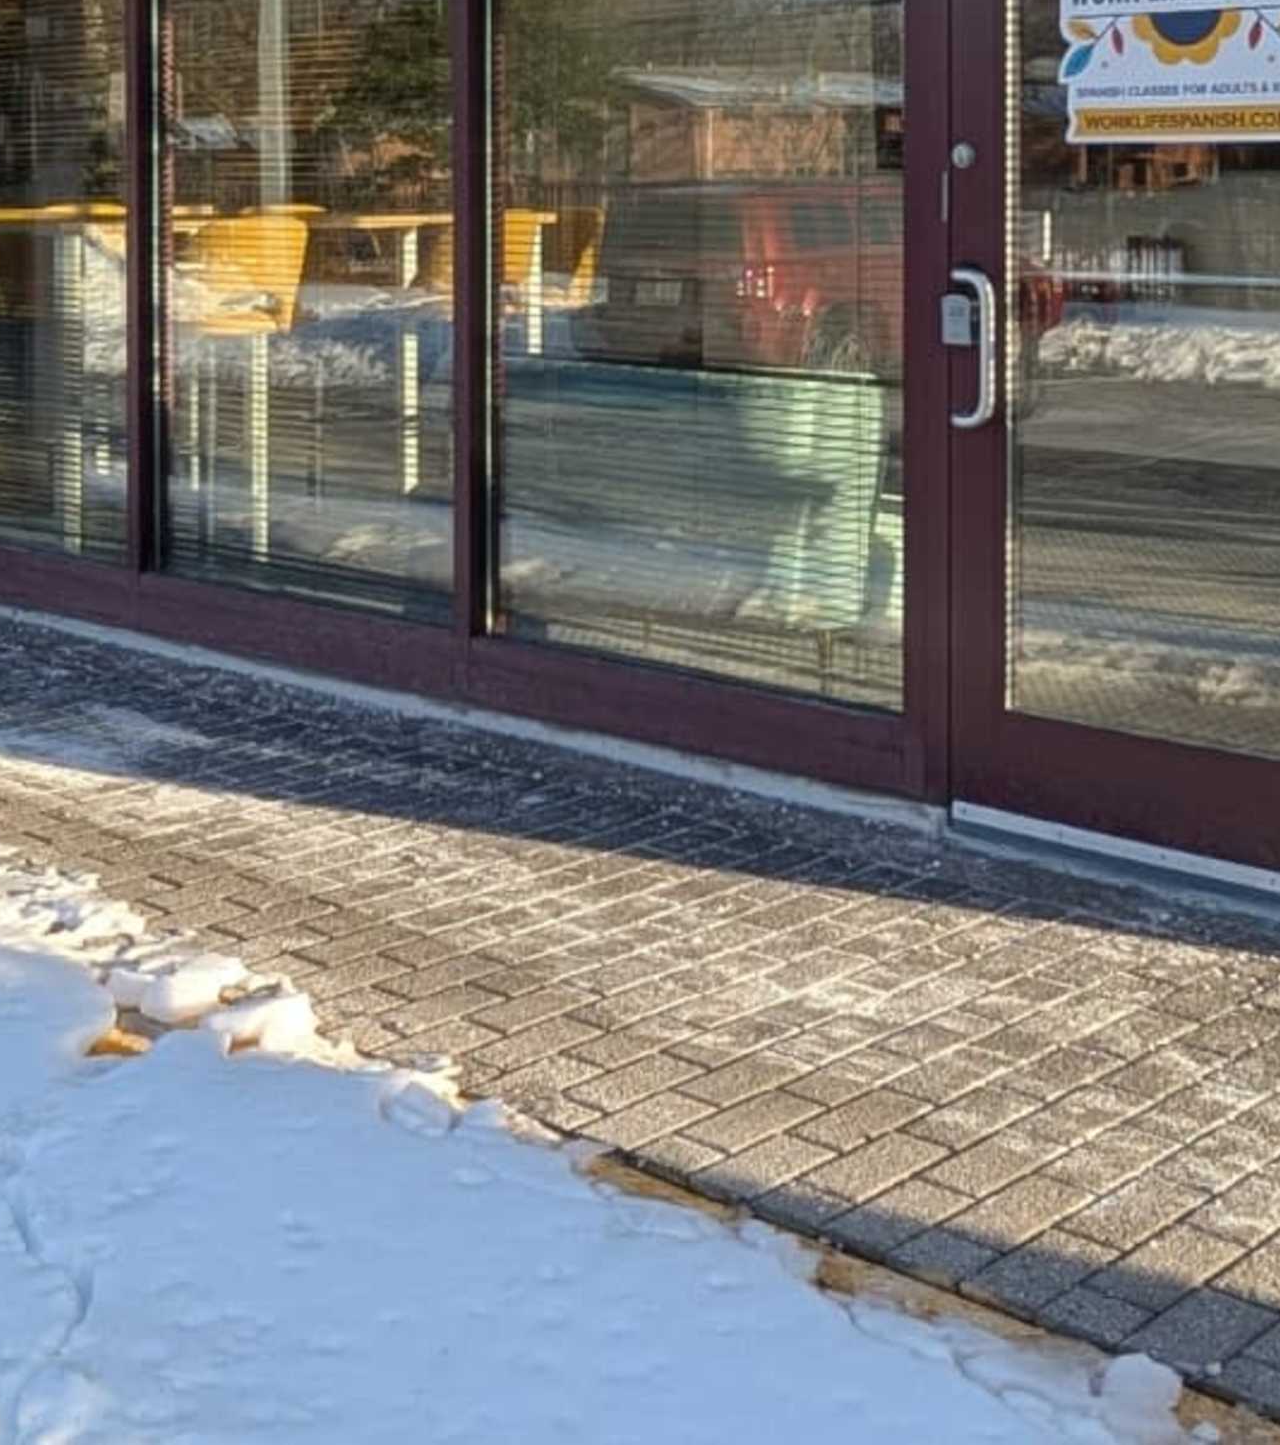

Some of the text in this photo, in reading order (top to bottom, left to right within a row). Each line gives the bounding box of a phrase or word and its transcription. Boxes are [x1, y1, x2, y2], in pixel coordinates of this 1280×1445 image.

[1128, 85, 1179, 97] CLASSES
[1183, 84, 1207, 96] FOR
[1211, 83, 1257, 95] ADULTS
